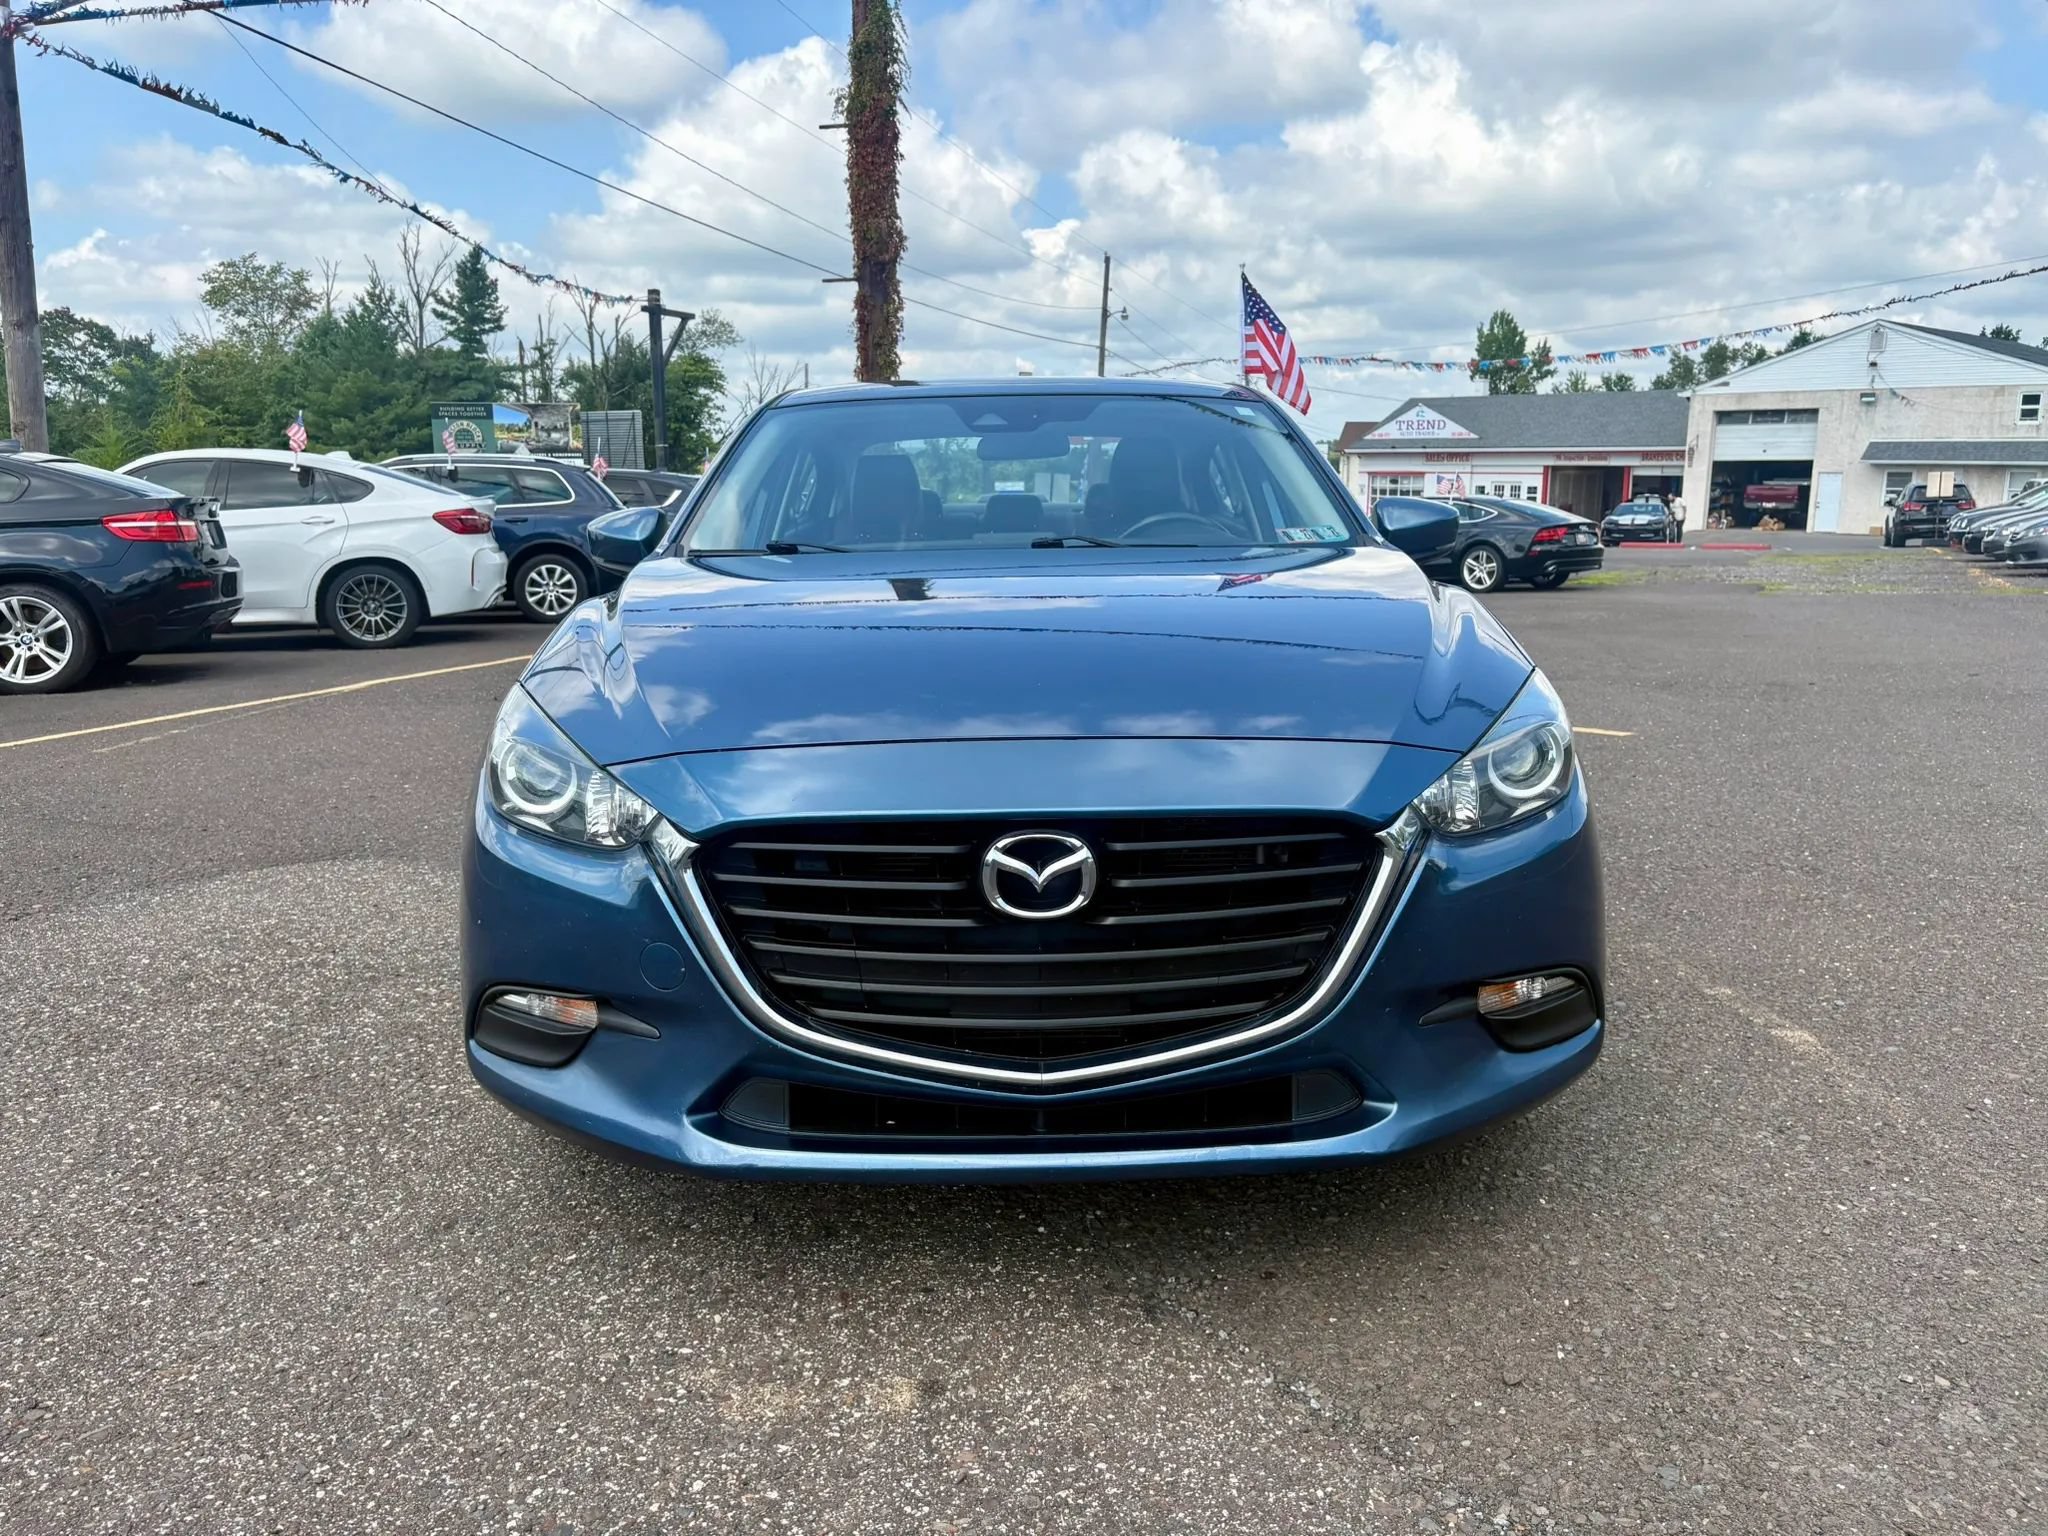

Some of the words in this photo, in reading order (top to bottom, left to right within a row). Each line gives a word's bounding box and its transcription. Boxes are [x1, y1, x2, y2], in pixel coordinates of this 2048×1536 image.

[1395, 419, 1447, 431] TREND
[1424, 453, 1446, 463] SALES
[1447, 453, 1471, 463] OFFICE
